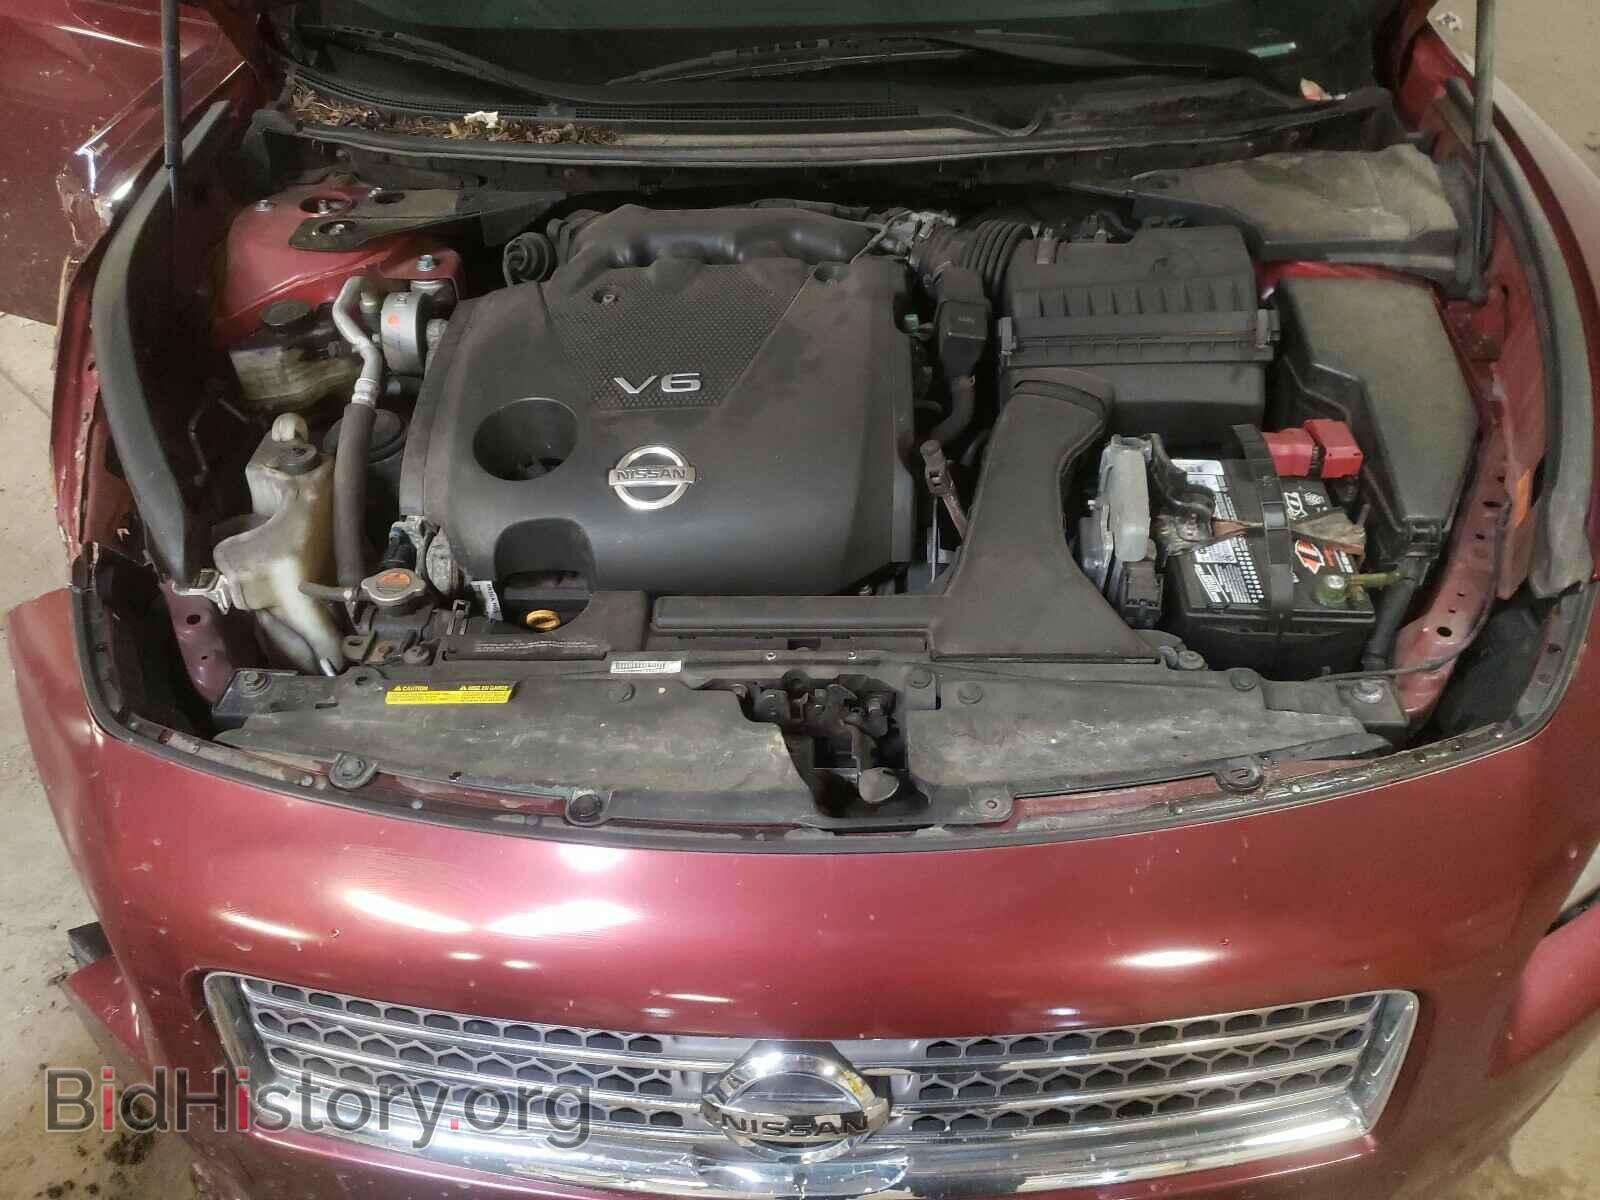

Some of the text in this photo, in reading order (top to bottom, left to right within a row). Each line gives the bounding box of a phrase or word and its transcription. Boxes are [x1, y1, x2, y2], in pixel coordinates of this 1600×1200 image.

[613, 372, 701, 394] V6
[616, 468, 686, 481] NISSAN
[721, 1112, 869, 1137] NISSAN
